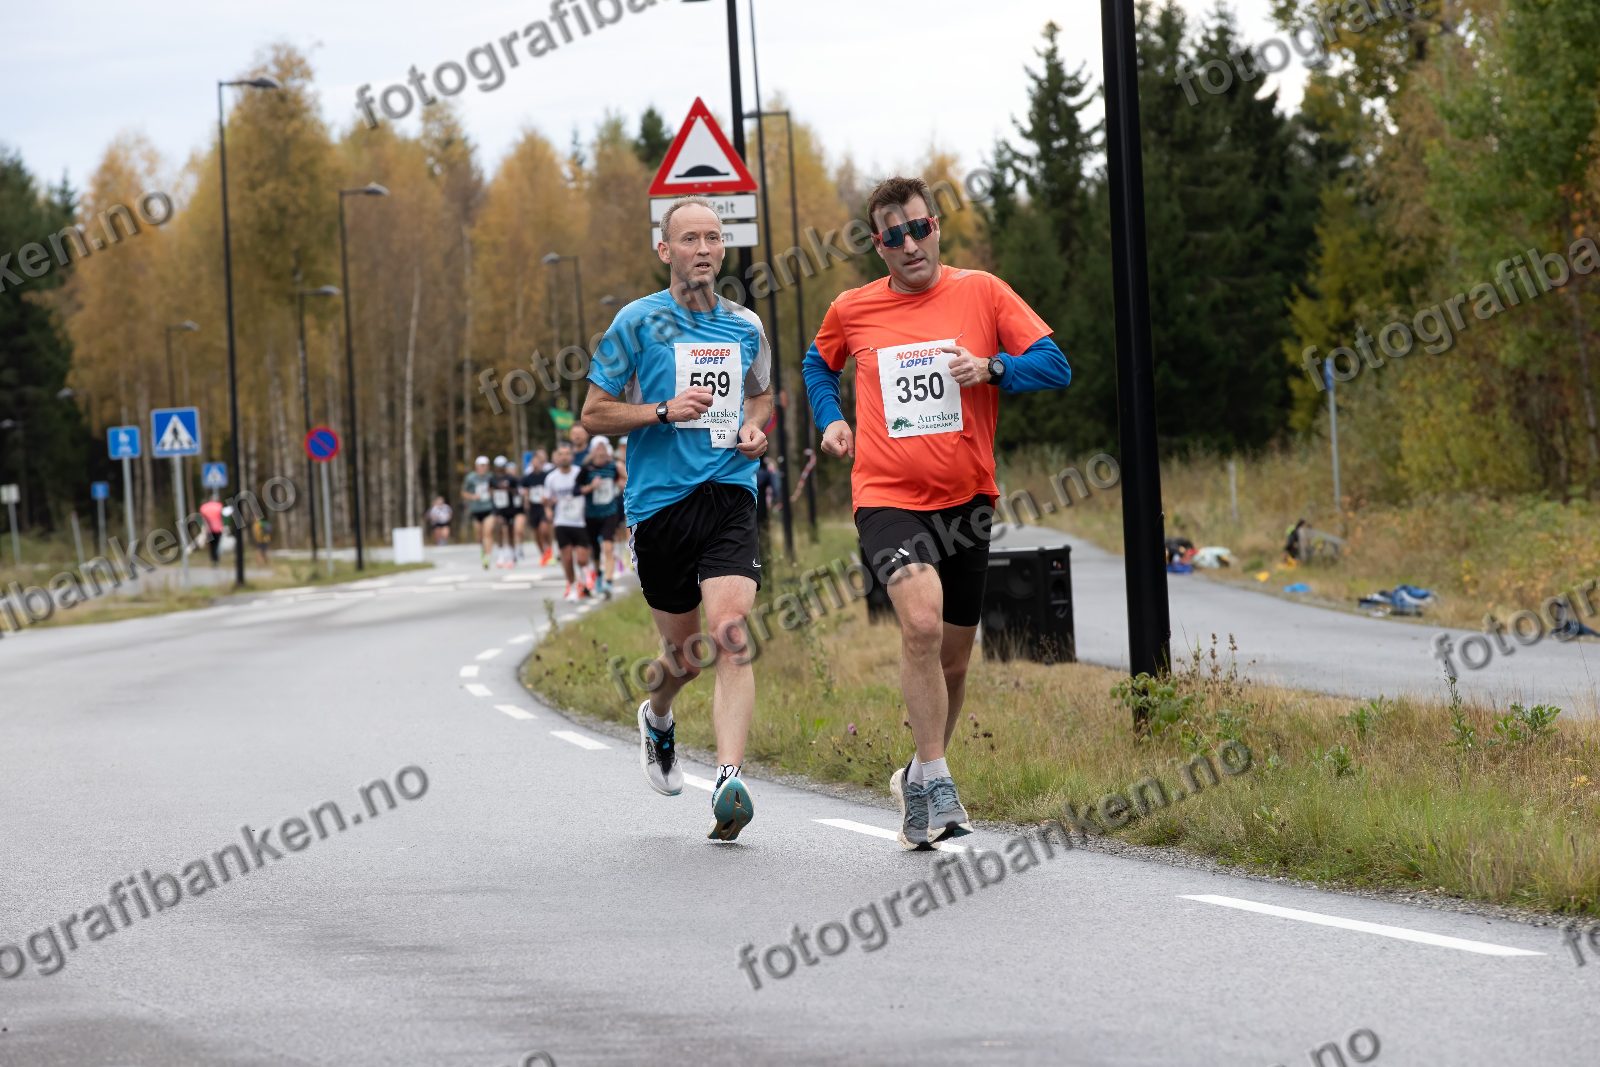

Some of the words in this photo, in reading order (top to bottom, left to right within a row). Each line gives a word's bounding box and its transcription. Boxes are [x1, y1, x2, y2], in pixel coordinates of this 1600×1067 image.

[690, 348, 731, 357] NORGES
[896, 347, 942, 360] NORGES
[694, 356, 726, 365] LØPET
[900, 356, 935, 369] LØPET
[690, 371, 730, 397] 569
[896, 371, 944, 403] 350
[917, 411, 960, 423] Aurskog
